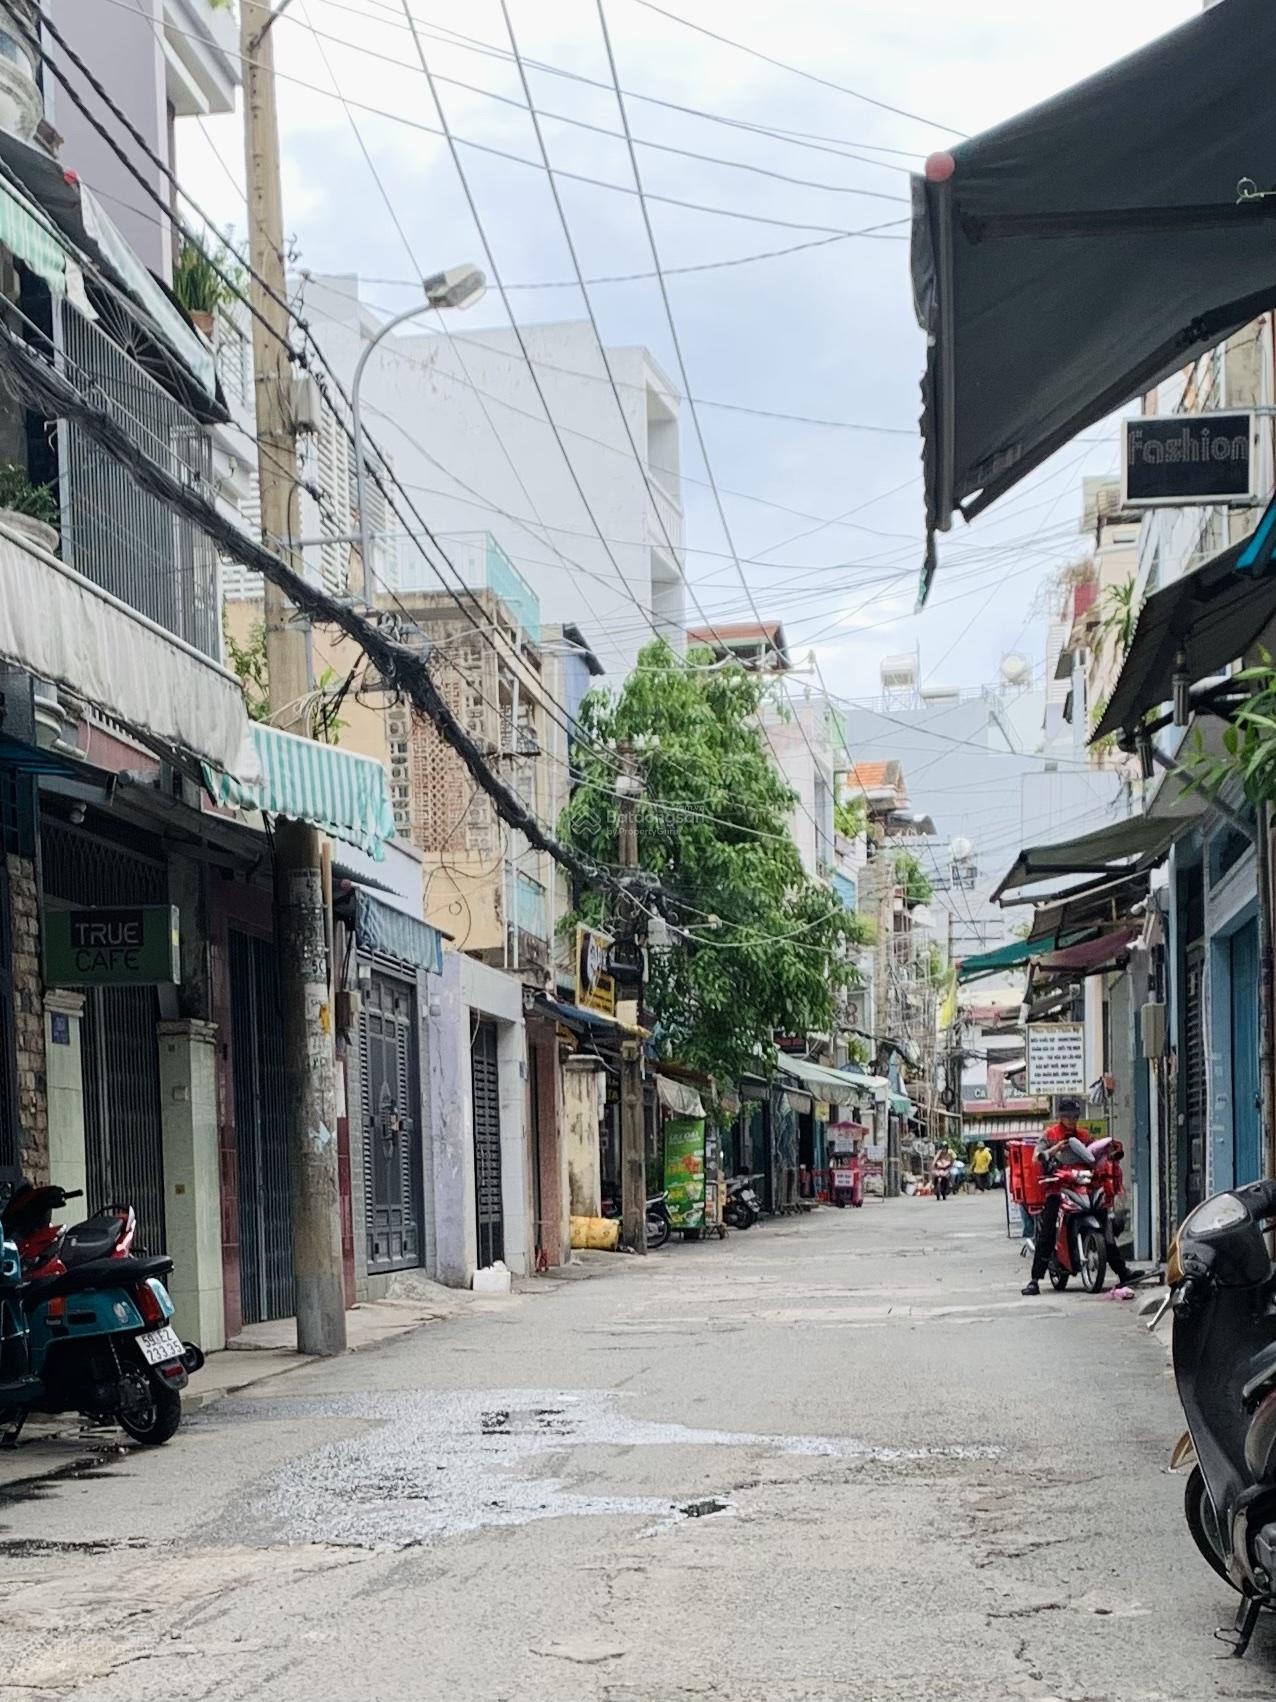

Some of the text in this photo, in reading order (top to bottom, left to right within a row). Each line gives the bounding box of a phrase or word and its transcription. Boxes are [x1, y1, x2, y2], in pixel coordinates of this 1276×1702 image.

[1128, 427, 1249, 465] Fashion
[75, 922, 140, 945] TRUE
[75, 948, 140, 972] CAFE
